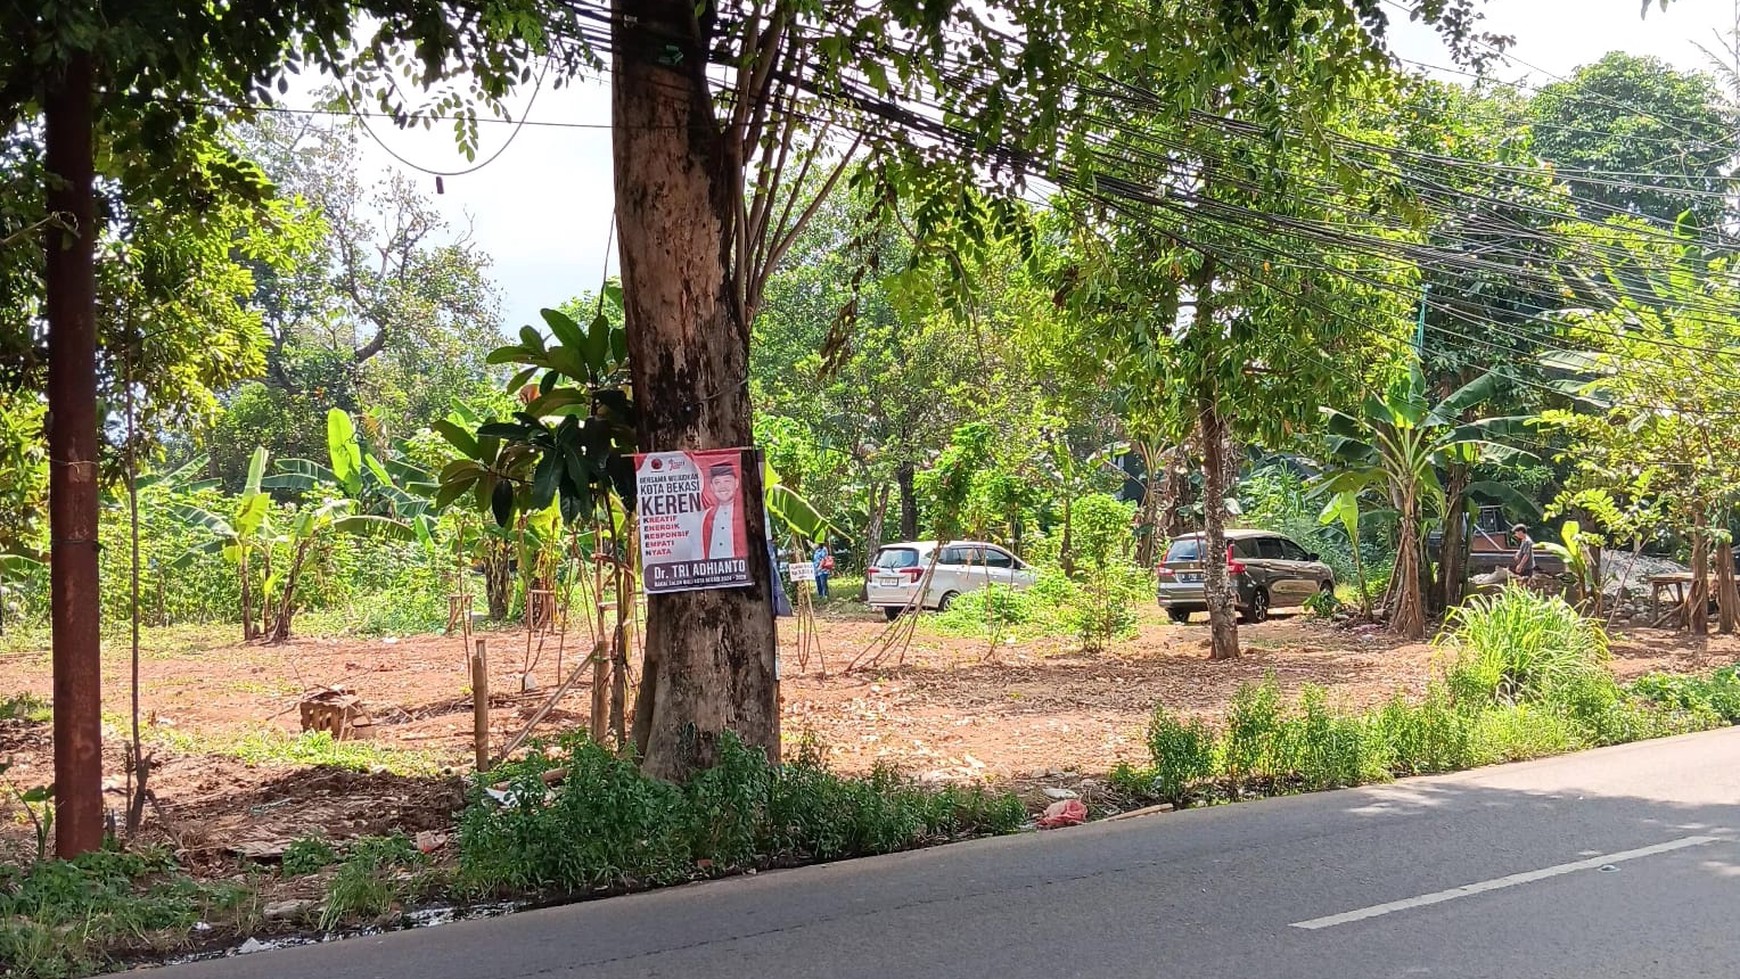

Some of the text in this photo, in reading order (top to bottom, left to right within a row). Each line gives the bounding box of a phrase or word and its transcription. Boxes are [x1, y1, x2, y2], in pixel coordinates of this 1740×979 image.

[640, 480, 700, 495] KOTA BEKASI
[641, 492, 701, 516] KEREN
[643, 515, 677, 524] KREATIF
[644, 530, 690, 540] RESPONSIF
[645, 540, 675, 549] EMPATI
[654, 560, 746, 580] Dr. TRI ADHIANTO
